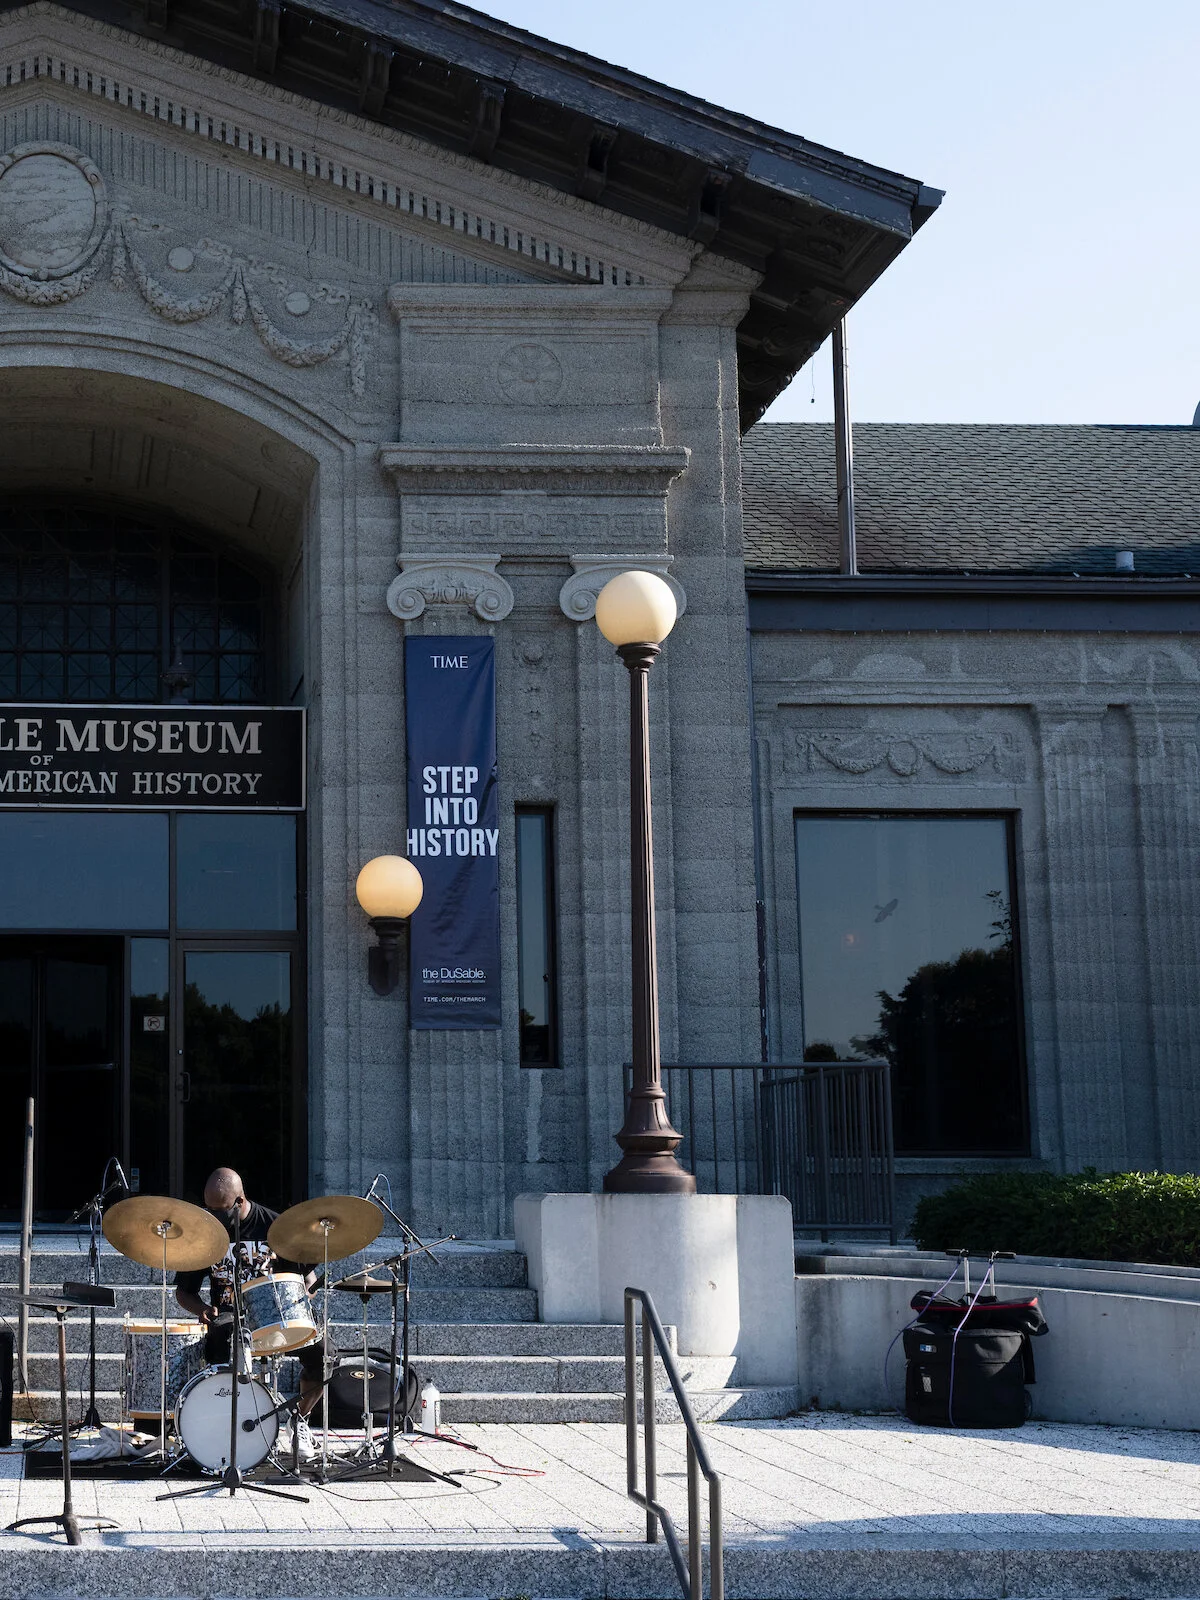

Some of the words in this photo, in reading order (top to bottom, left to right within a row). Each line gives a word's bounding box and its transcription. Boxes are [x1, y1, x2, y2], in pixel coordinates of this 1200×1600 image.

[430, 655, 469, 669] TIME
[55, 719, 263, 754] MUSEUM
[30, 755, 54, 766] OF
[132, 772, 263, 795] HISTORY
[422, 765, 479, 794] STEP
[425, 797, 478, 826] INTO
[406, 828, 500, 857] HISTORY
[422, 968, 439, 979] the
